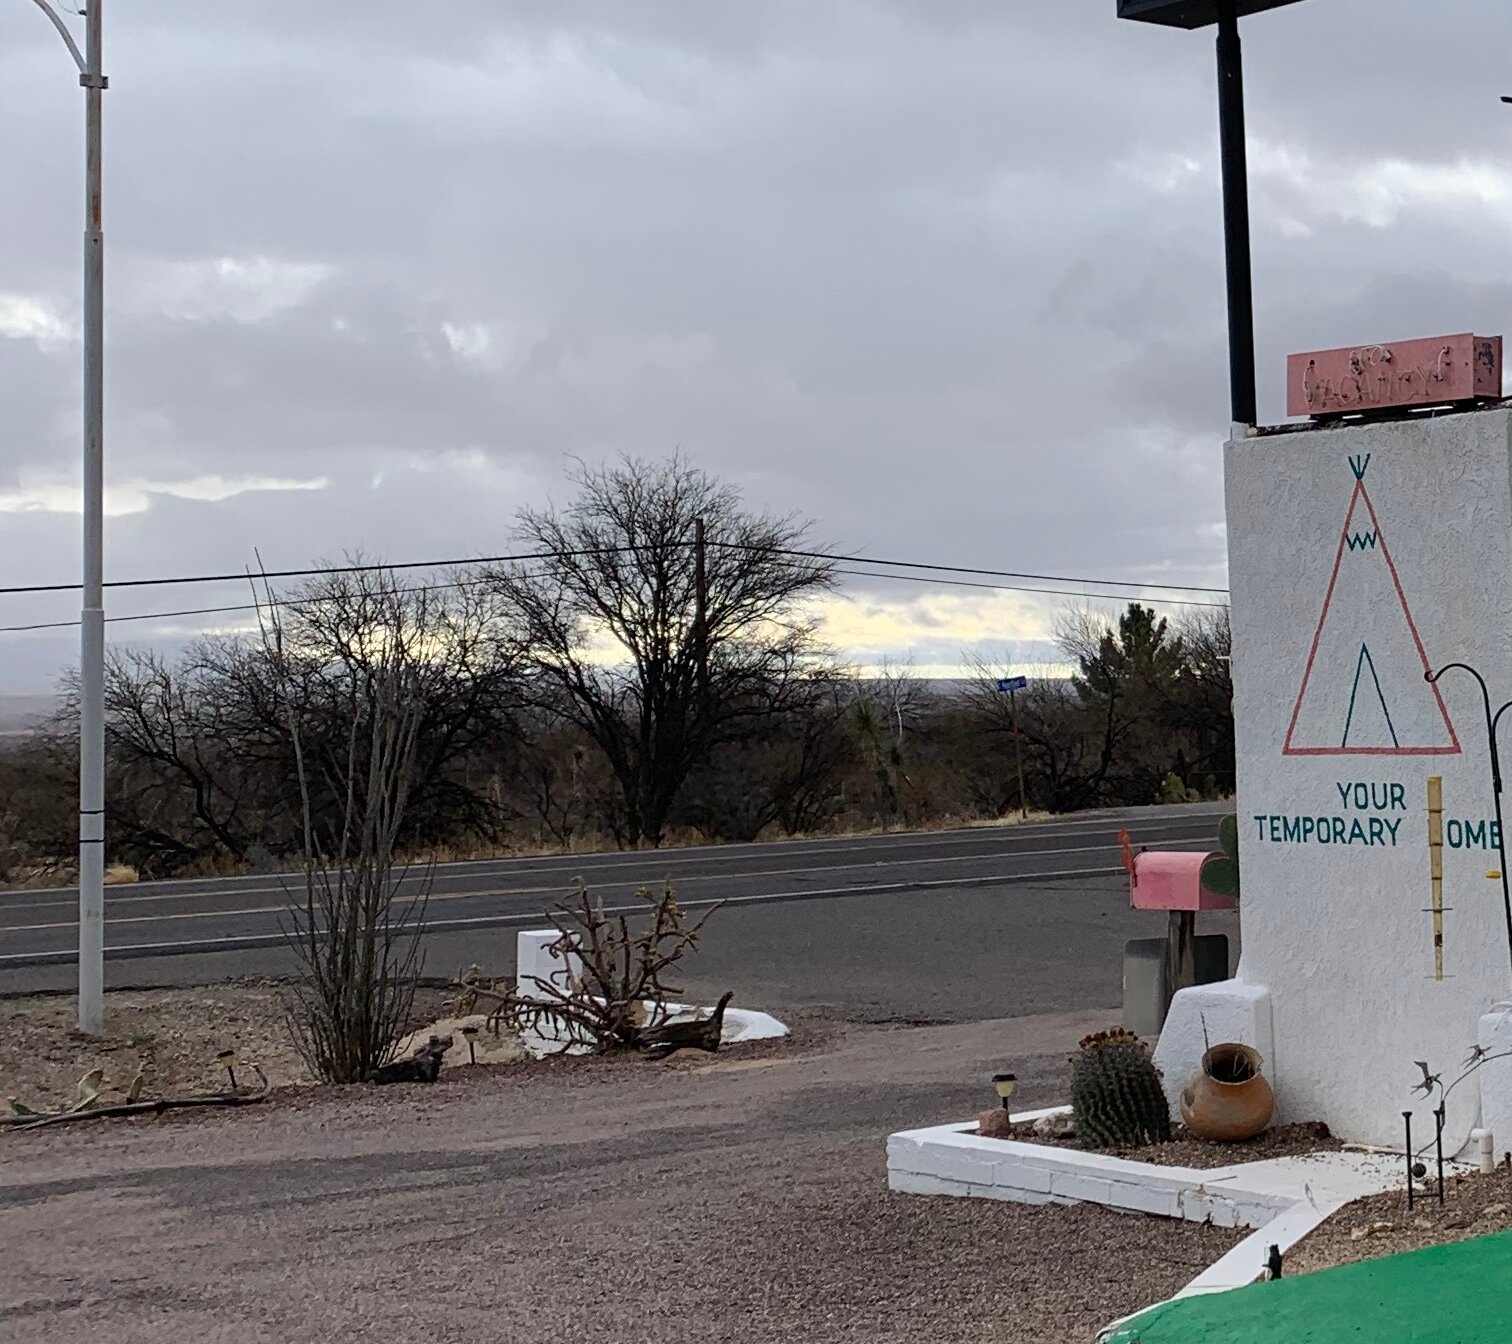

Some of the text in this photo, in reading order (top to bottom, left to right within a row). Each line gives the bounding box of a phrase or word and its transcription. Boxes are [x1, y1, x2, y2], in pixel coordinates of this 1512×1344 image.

[1336, 782, 1407, 810] YOUR
[1254, 815, 1501, 849] TEMPORARY OME
